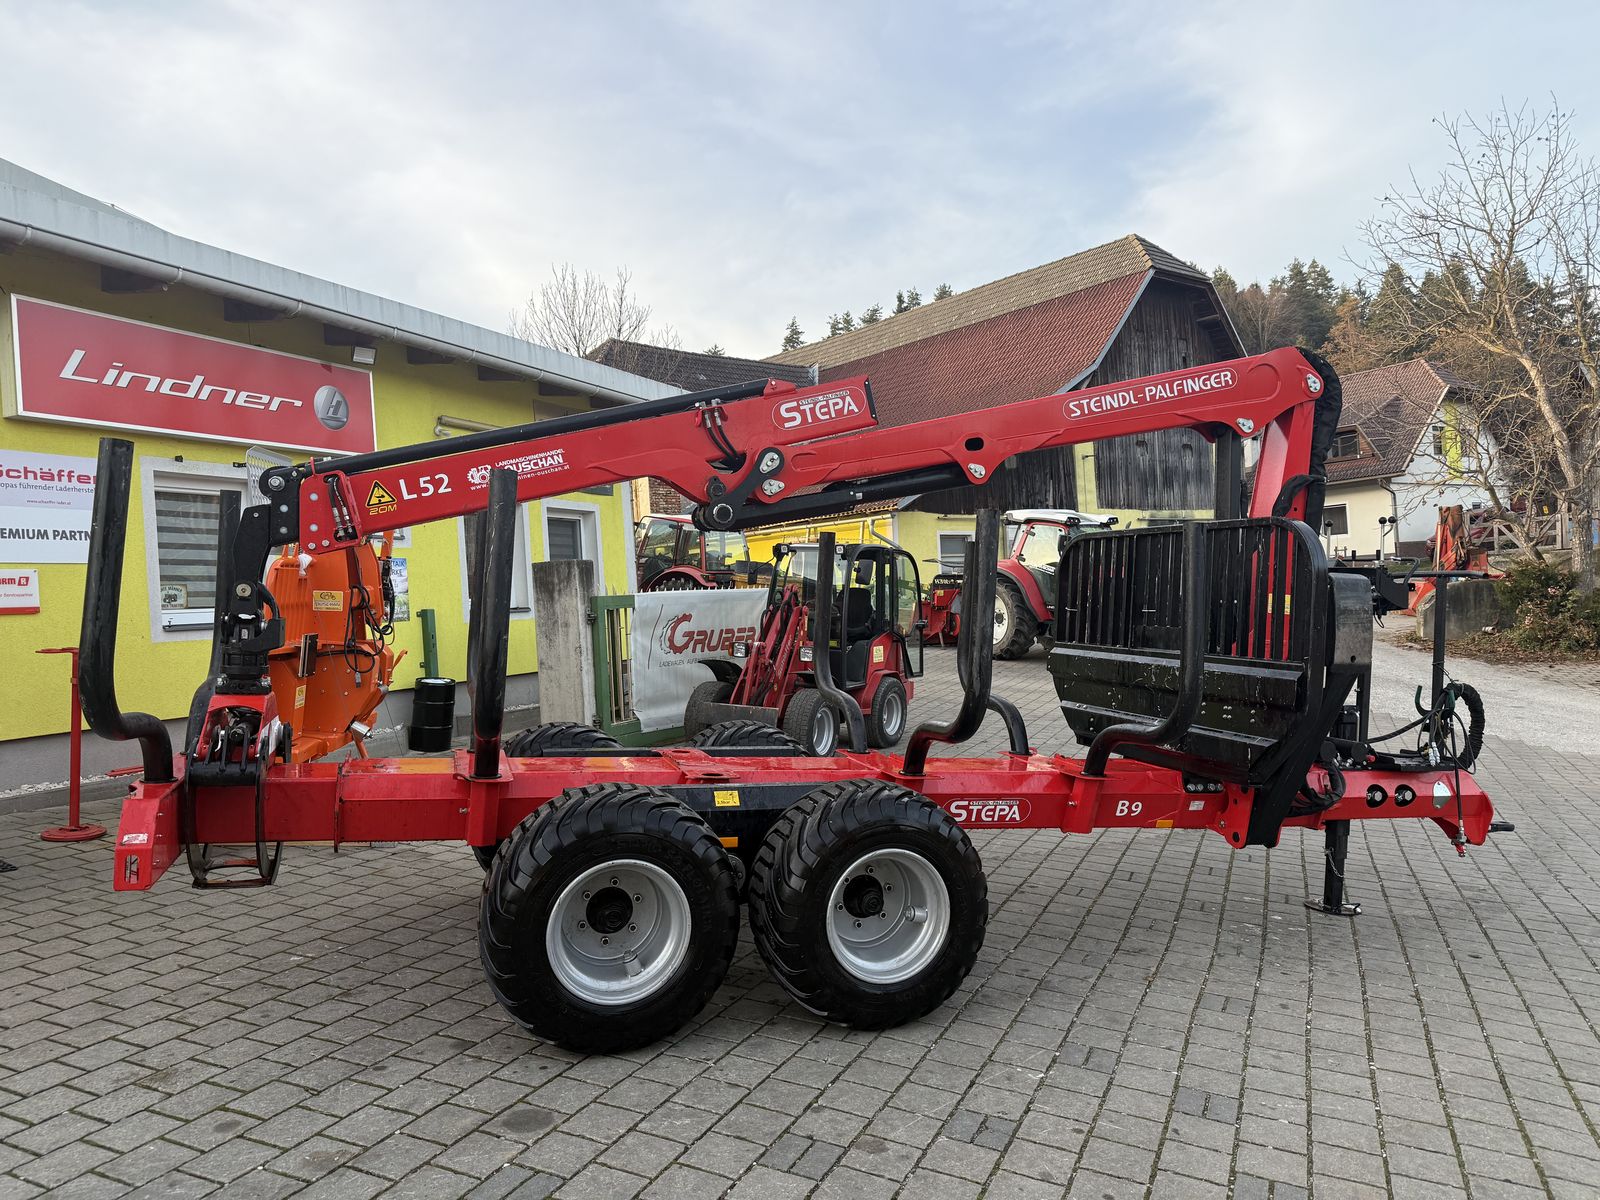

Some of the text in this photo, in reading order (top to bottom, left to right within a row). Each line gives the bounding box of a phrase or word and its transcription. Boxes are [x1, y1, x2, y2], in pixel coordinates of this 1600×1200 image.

[59, 348, 303, 412] Lindner
[1068, 370, 1233, 417] STEINDL-PALFINGER
[780, 395, 859, 428] STEPA
[495, 448, 565, 467] LANDMASCHINENHANDEL
[0, 464, 97, 485] chäffe
[19, 483, 54, 491] führender
[0, 528, 50, 541] EMIUM
[667, 612, 757, 655] GRUBER
[949, 800, 1021, 822] STEPA
[1115, 800, 1143, 817] B9
